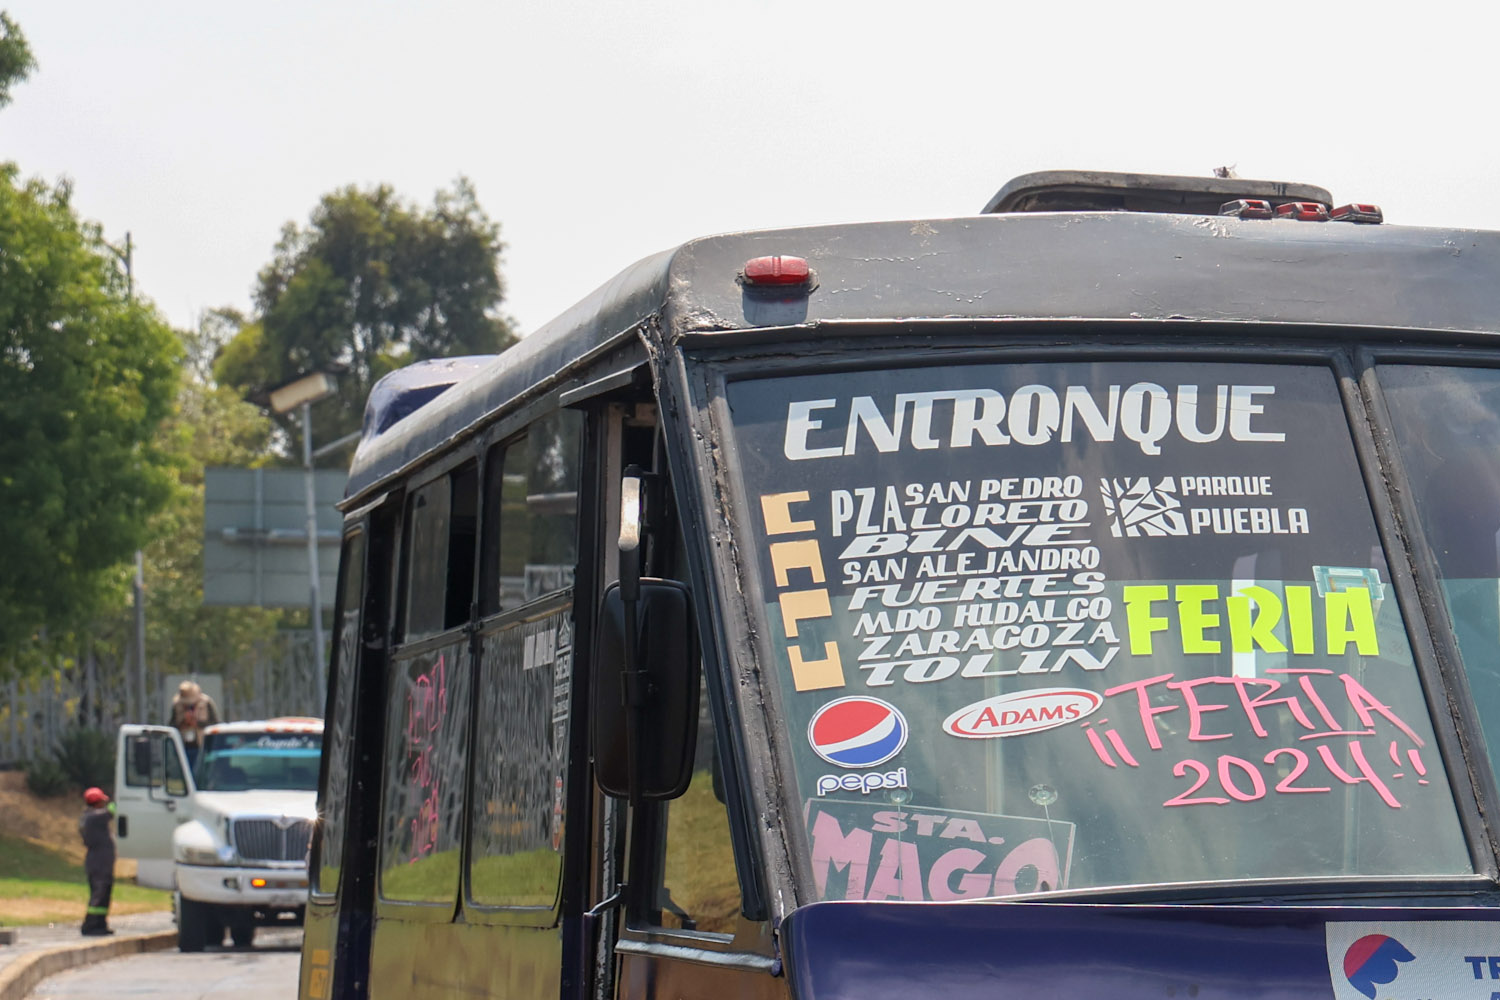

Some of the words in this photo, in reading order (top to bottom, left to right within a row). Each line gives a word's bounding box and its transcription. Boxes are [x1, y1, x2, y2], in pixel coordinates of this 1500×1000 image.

[783, 381, 1286, 461] ENTRONQUE
[904, 480, 971, 506] SAN
[979, 475, 1083, 501] PEDRO
[1180, 476, 1273, 496] PARQUE
[831, 485, 906, 537] PZA
[910, 499, 1088, 529] LORETO
[1190, 507, 1309, 535] PUEBLA
[838, 522, 1091, 559] BINE
[842, 557, 908, 585] SAN
[916, 546, 1100, 578] ALEJANDRO
[847, 572, 1106, 610] FUERTES
[853, 606, 942, 636] MDO
[953, 597, 1112, 628] HIDALGO
[1123, 584, 1379, 656] FERIA
[857, 621, 1120, 661] ZARAGOZA
[859, 646, 1120, 687] TOLIN
[972, 703, 1080, 730] ADAMS
[817, 767, 908, 796] pepsi
[871, 811, 1005, 844] STA.
